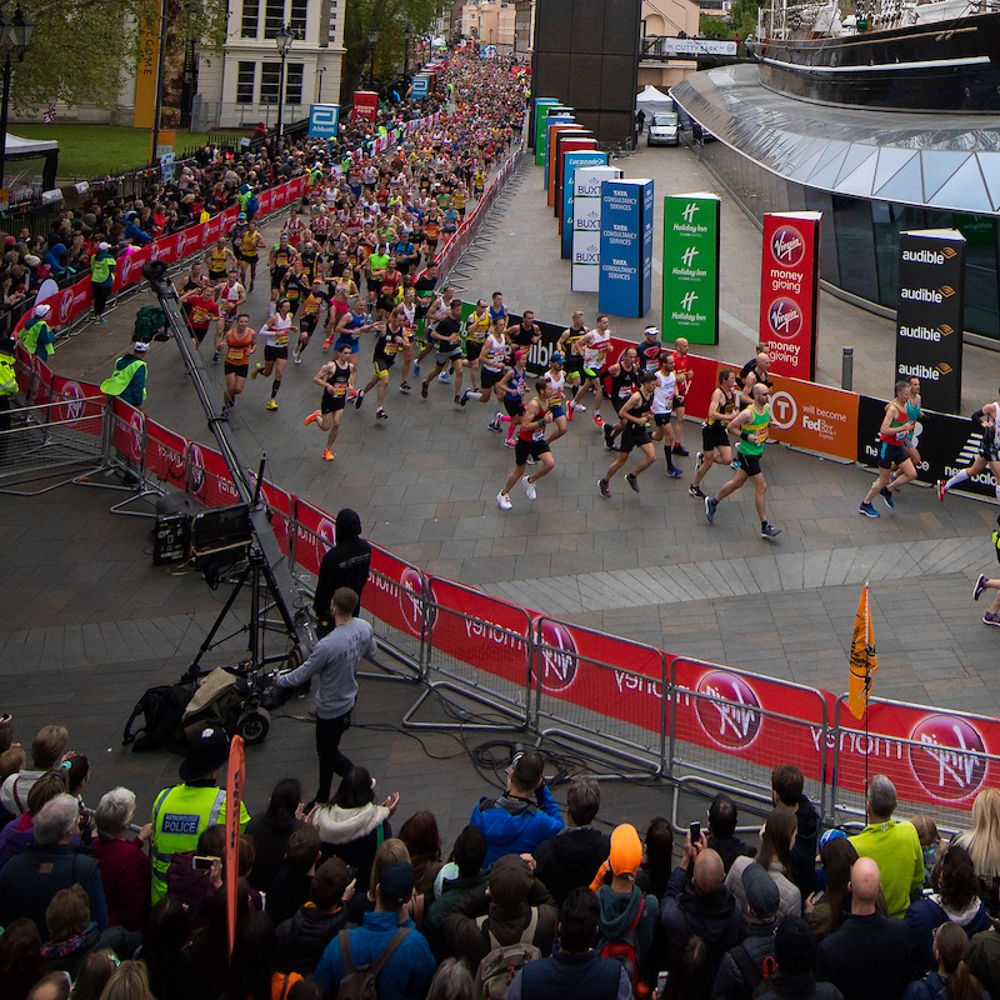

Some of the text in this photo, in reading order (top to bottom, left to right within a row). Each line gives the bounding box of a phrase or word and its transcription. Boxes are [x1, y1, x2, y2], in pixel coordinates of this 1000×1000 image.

[578, 186, 601, 194] BUXT
[576, 219, 600, 228] BUXT
[673, 224, 697, 233] Holiday
[774, 231, 802, 261] Virgin
[576, 253, 600, 262] BUXT
[902, 250, 944, 265] audible
[672, 267, 696, 277] Holiday
[771, 269, 803, 283] money
[901, 288, 943, 303] audible
[771, 302, 799, 333] Virgin
[900, 326, 941, 342] audible
[768, 341, 800, 355] money
[898, 364, 940, 380] audible
[803, 405, 847, 422] will become
[164, 821, 196, 832] POLICE
